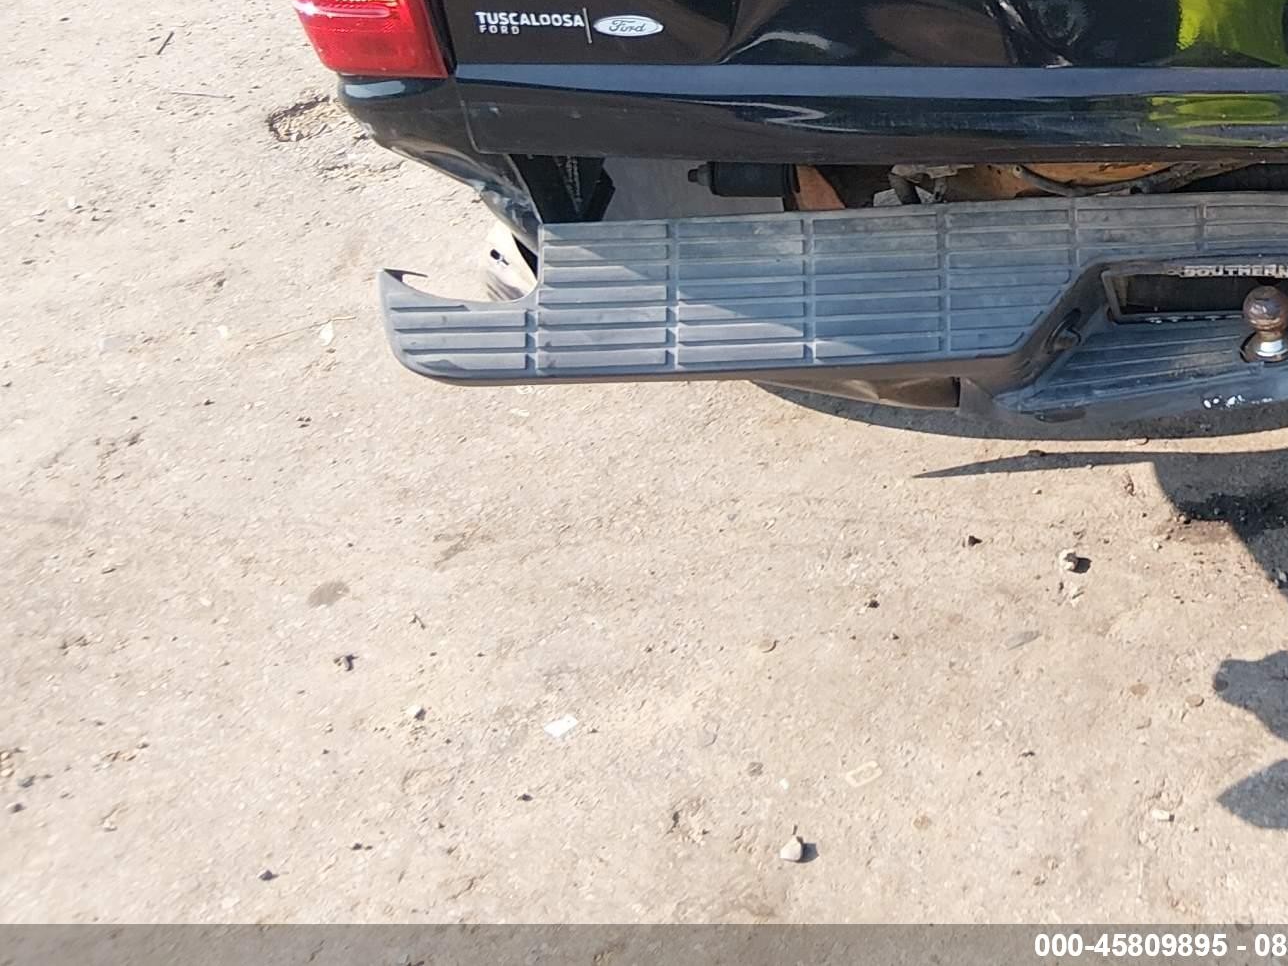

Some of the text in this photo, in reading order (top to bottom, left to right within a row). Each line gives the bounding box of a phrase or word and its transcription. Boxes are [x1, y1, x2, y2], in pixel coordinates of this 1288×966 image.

[475, 11, 585, 27] TUSCALOOSA
[608, 18, 647, 33] Ford
[480, 25, 520, 35] FORD
